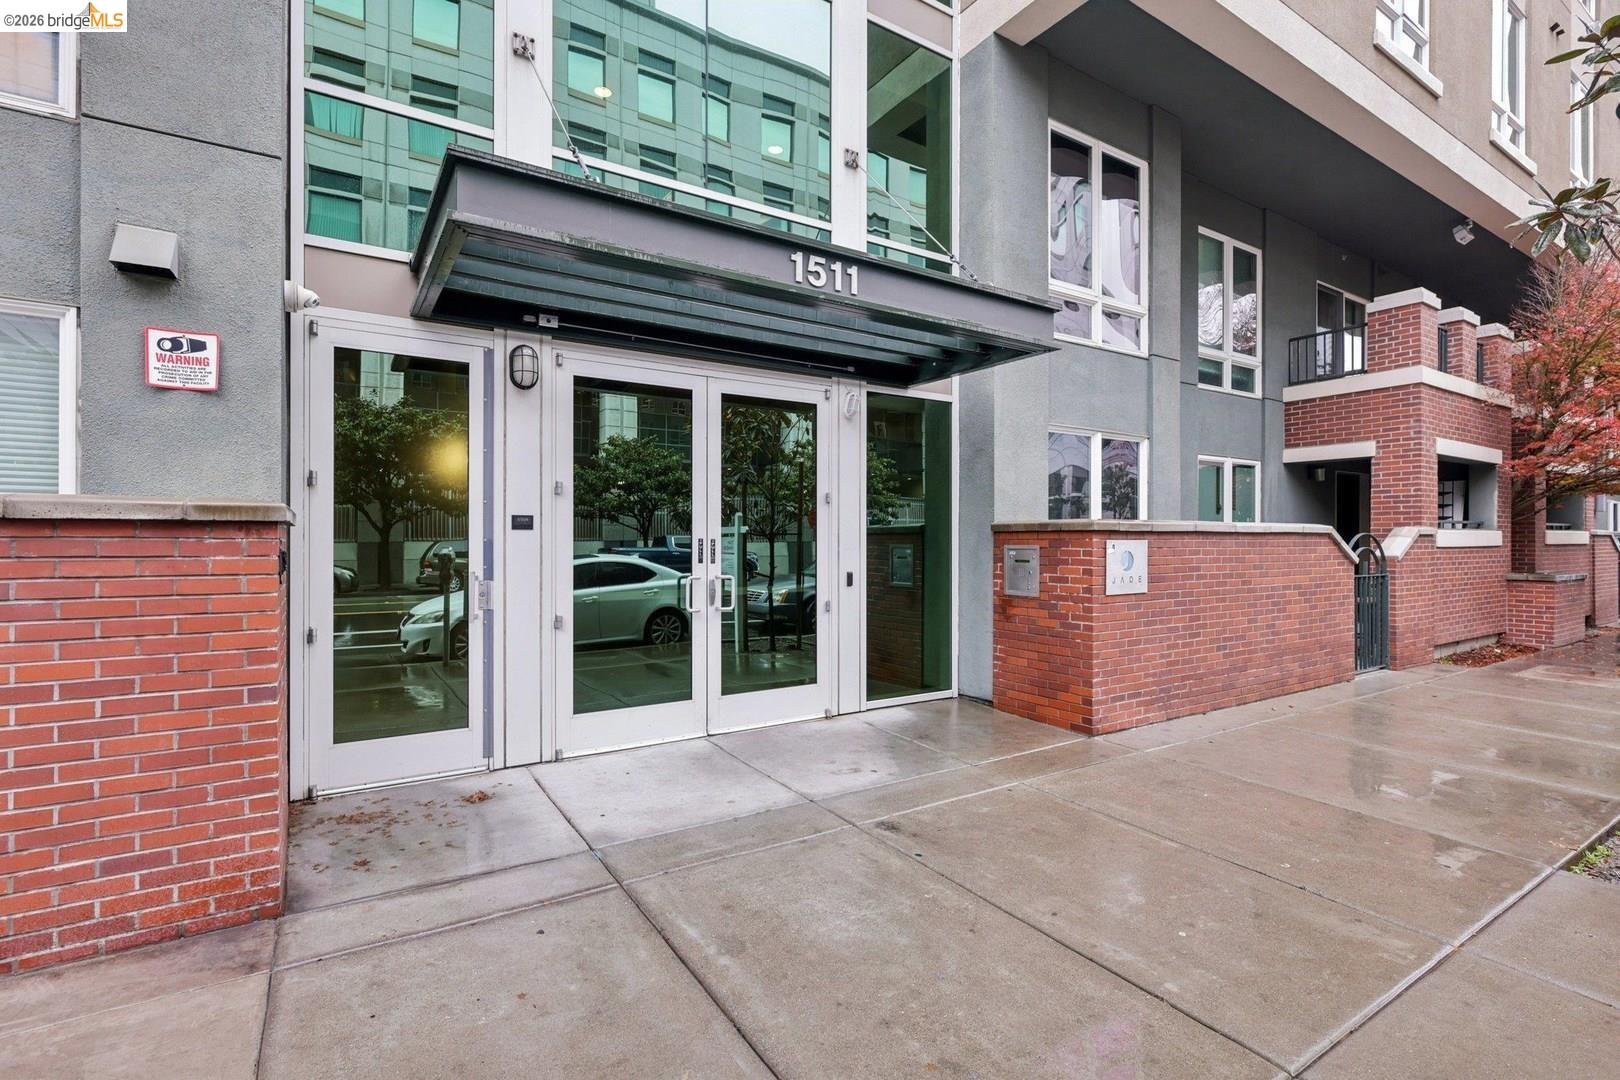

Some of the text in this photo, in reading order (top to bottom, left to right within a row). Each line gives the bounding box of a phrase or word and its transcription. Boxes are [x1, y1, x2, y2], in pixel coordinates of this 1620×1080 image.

[791, 252, 858, 295] 1511
[156, 352, 210, 367] WARNING
[1112, 575, 1142, 584] JADE
